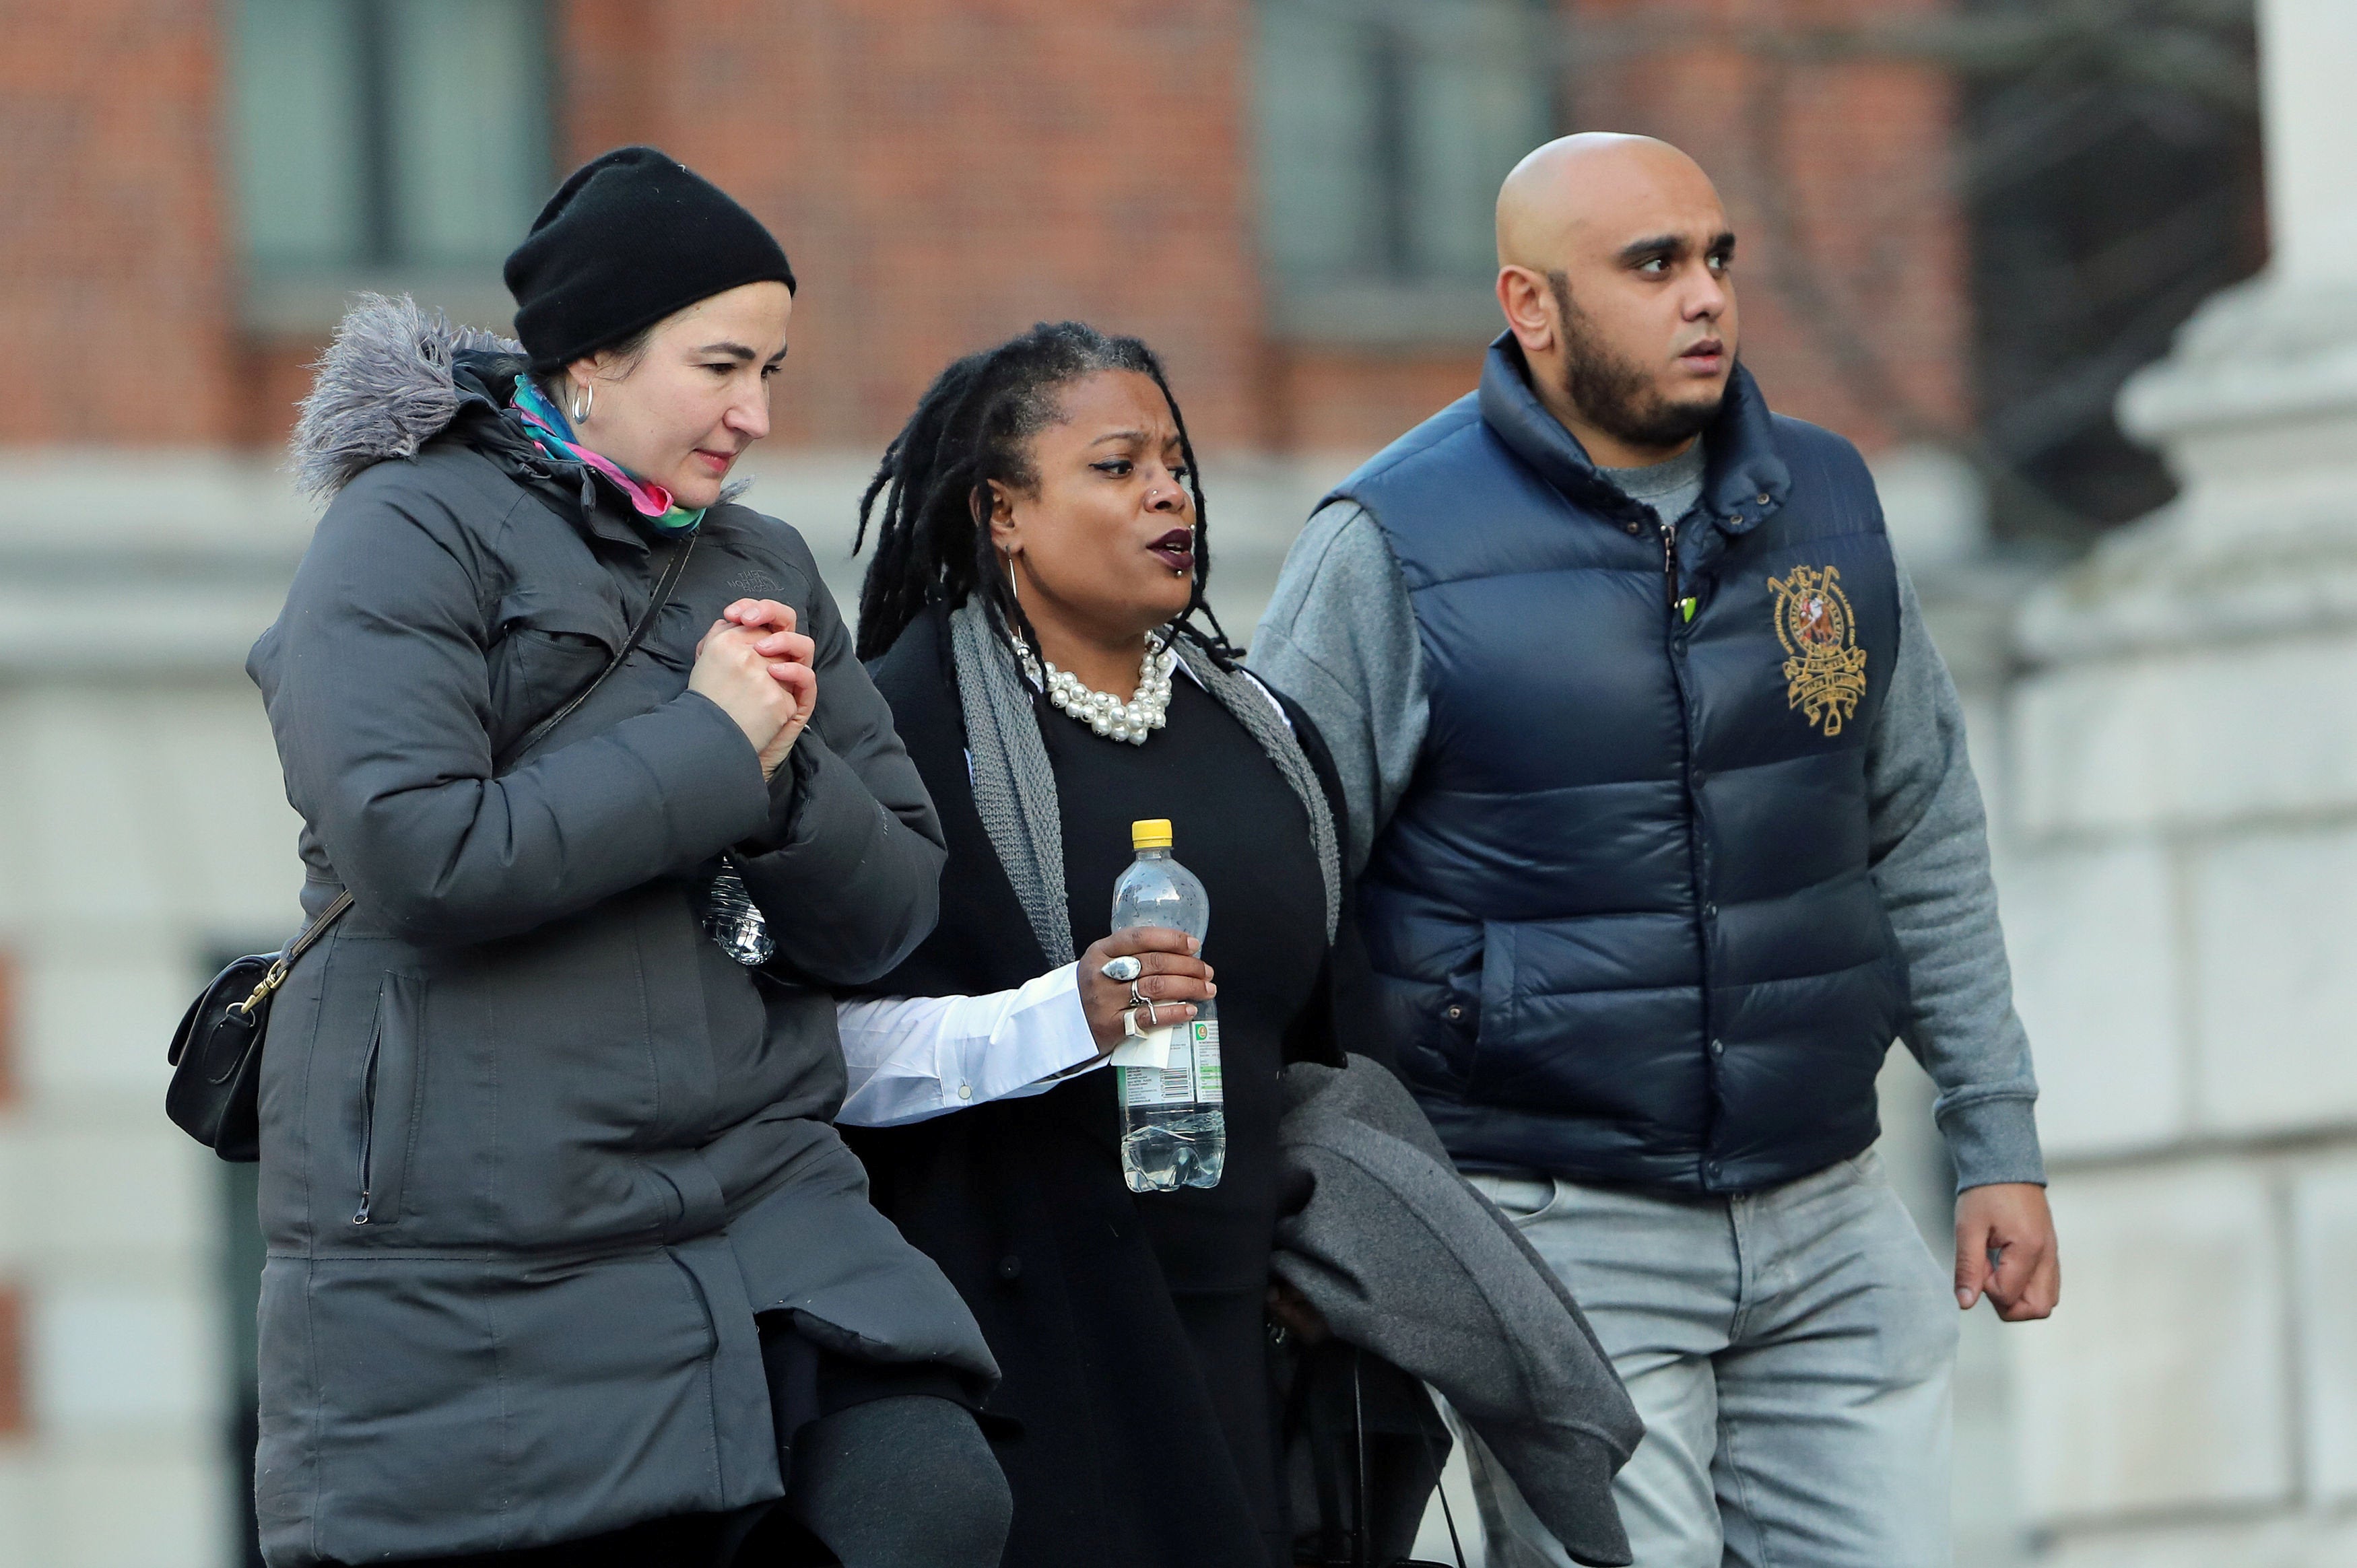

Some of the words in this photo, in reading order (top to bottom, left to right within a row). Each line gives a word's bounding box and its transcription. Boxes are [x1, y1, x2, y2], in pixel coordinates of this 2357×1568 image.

[737, 570, 761, 579] THE
[727, 577, 766, 588] NORTH
[743, 584, 766, 593] FACE
